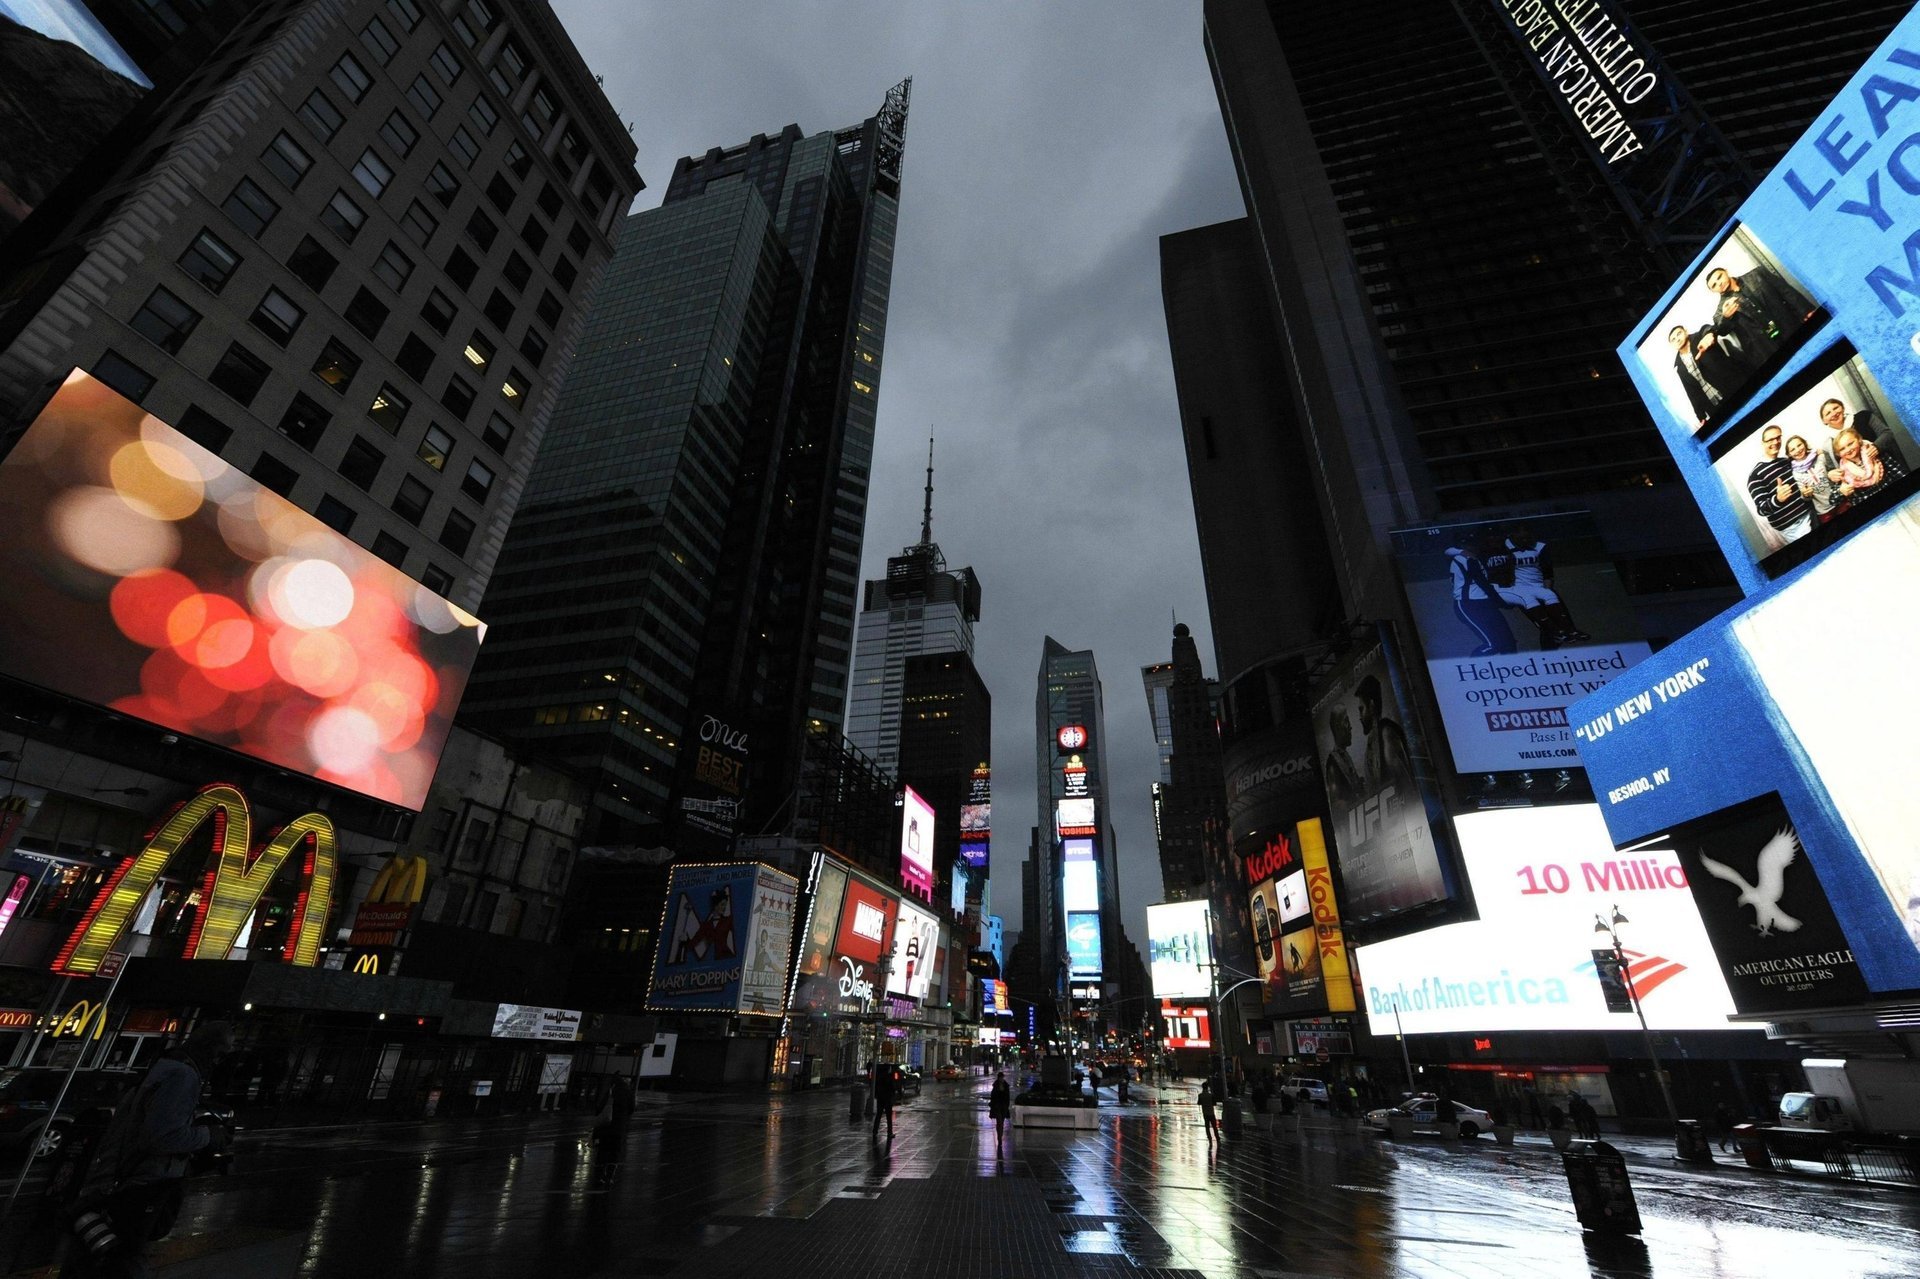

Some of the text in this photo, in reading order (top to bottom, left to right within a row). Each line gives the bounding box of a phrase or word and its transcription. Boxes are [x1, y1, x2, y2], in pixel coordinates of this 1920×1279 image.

[1540, 36, 1643, 164] AMERICAN
[1457, 650, 1626, 684] Helped injured
[1465, 674, 1612, 707] opponent wi
[1490, 709, 1569, 729] SPORTSM
[1614, 691, 1653, 725] NEW
[1530, 731, 1569, 743] Pass It
[698, 744, 743, 780] BEST
[1518, 749, 1578, 760] VALUES.COM
[1653, 767, 1670, 786] NY
[1349, 785, 1395, 848] UFC
[1059, 827, 1096, 835] TOSHIBA
[1245, 832, 1294, 885] Kodak
[1516, 864, 1571, 895] 10
[357, 910, 409, 921] McDonald's
[1307, 866, 1342, 958] Kodak
[654, 966, 741, 990] MARY POPPINS
[1733, 956, 1805, 977] AMERICAN
[1760, 968, 1834, 986] OUTFITTERS
[1369, 969, 1570, 1015] Bank of America
[1786, 982, 1815, 992] ae.com
